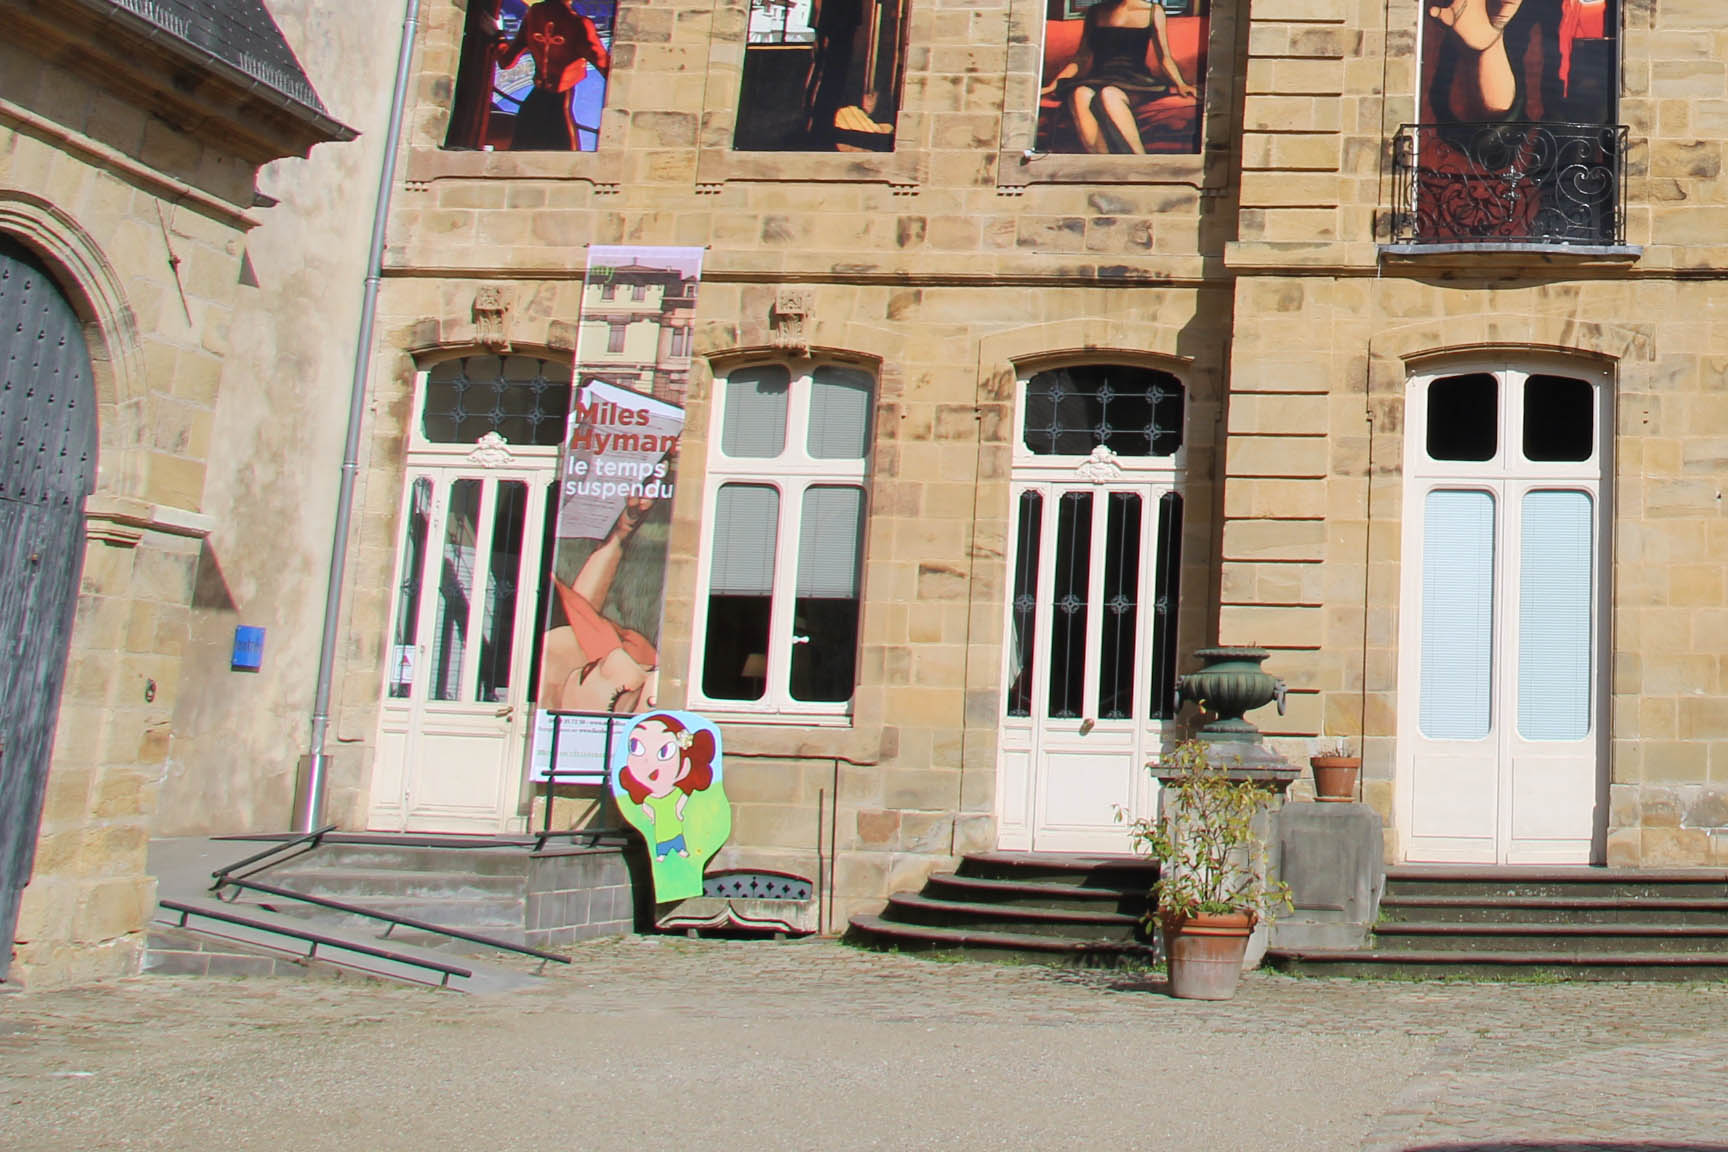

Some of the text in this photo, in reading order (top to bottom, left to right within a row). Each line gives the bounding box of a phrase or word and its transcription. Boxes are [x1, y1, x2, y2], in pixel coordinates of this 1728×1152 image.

[575, 402, 650, 426] Miles
[571, 427, 678, 455] Hyman
[568, 455, 666, 481] le temps
[565, 479, 673, 499] suspendu
